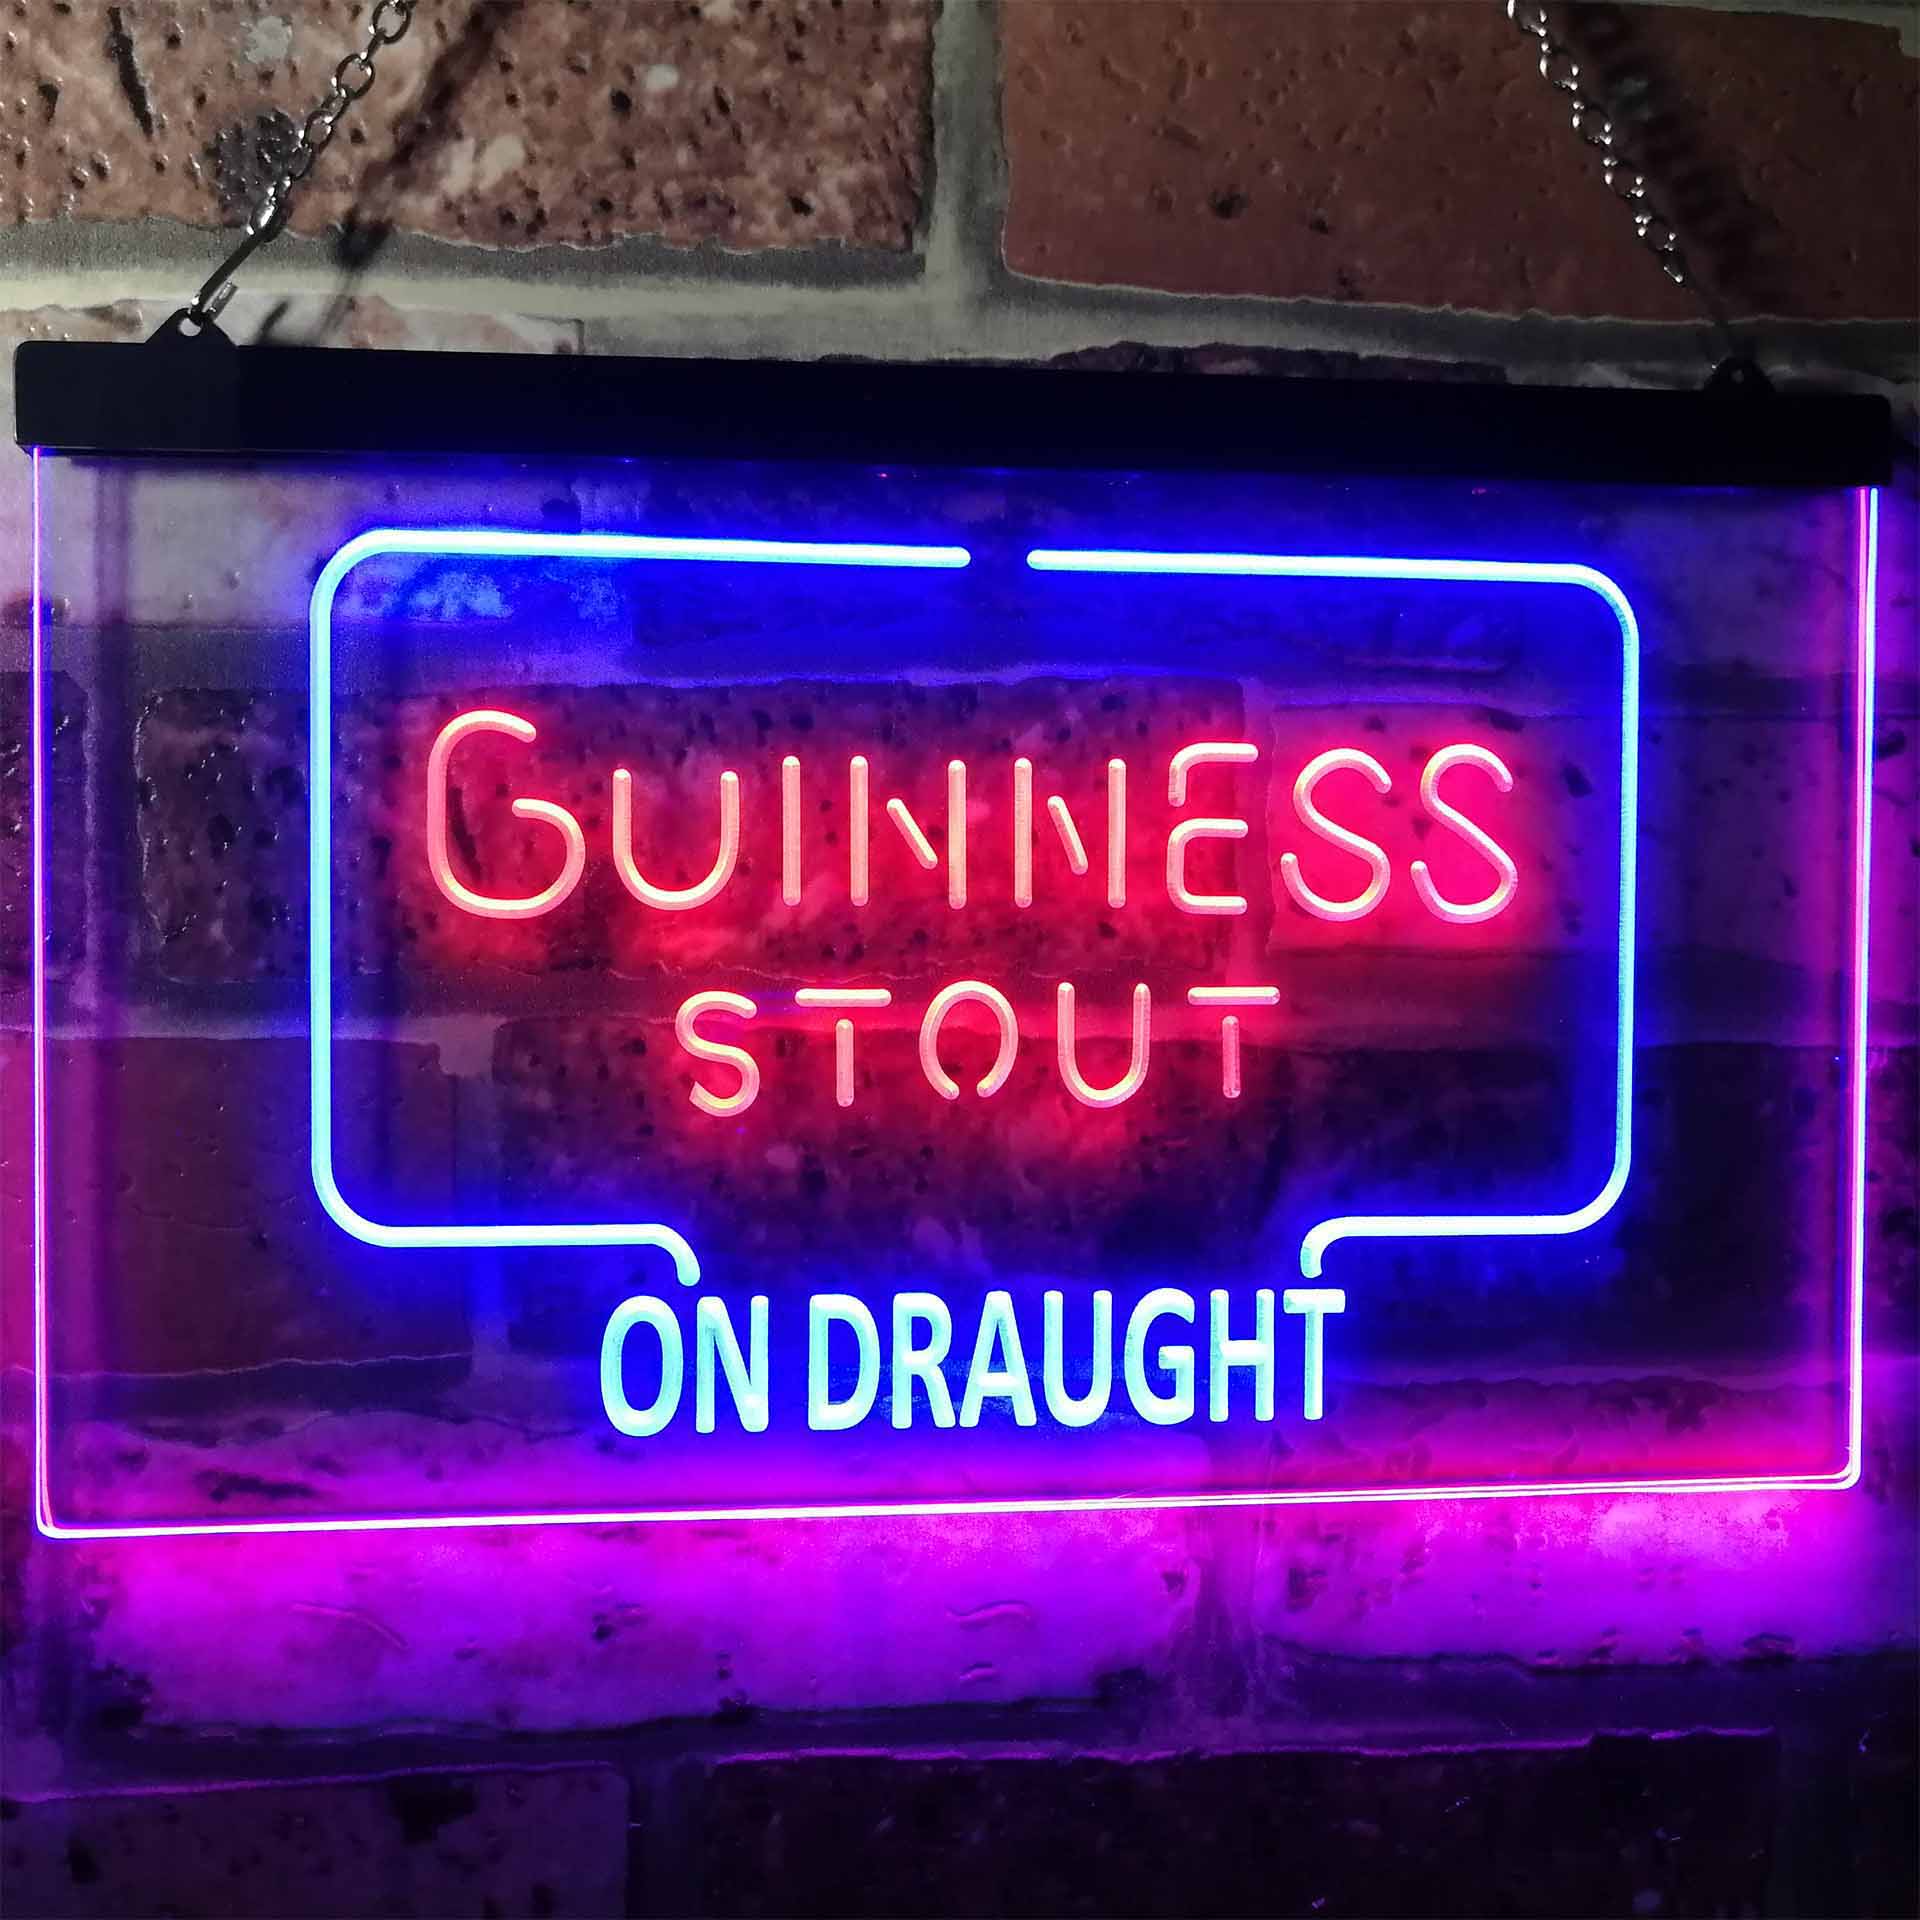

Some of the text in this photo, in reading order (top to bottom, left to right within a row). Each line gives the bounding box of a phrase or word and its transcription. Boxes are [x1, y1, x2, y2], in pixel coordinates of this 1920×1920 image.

[427, 709, 1519, 921] GUINNESS
[675, 980, 1280, 1117] STOUT
[600, 1287, 1346, 1437] ON DRAUGHT
